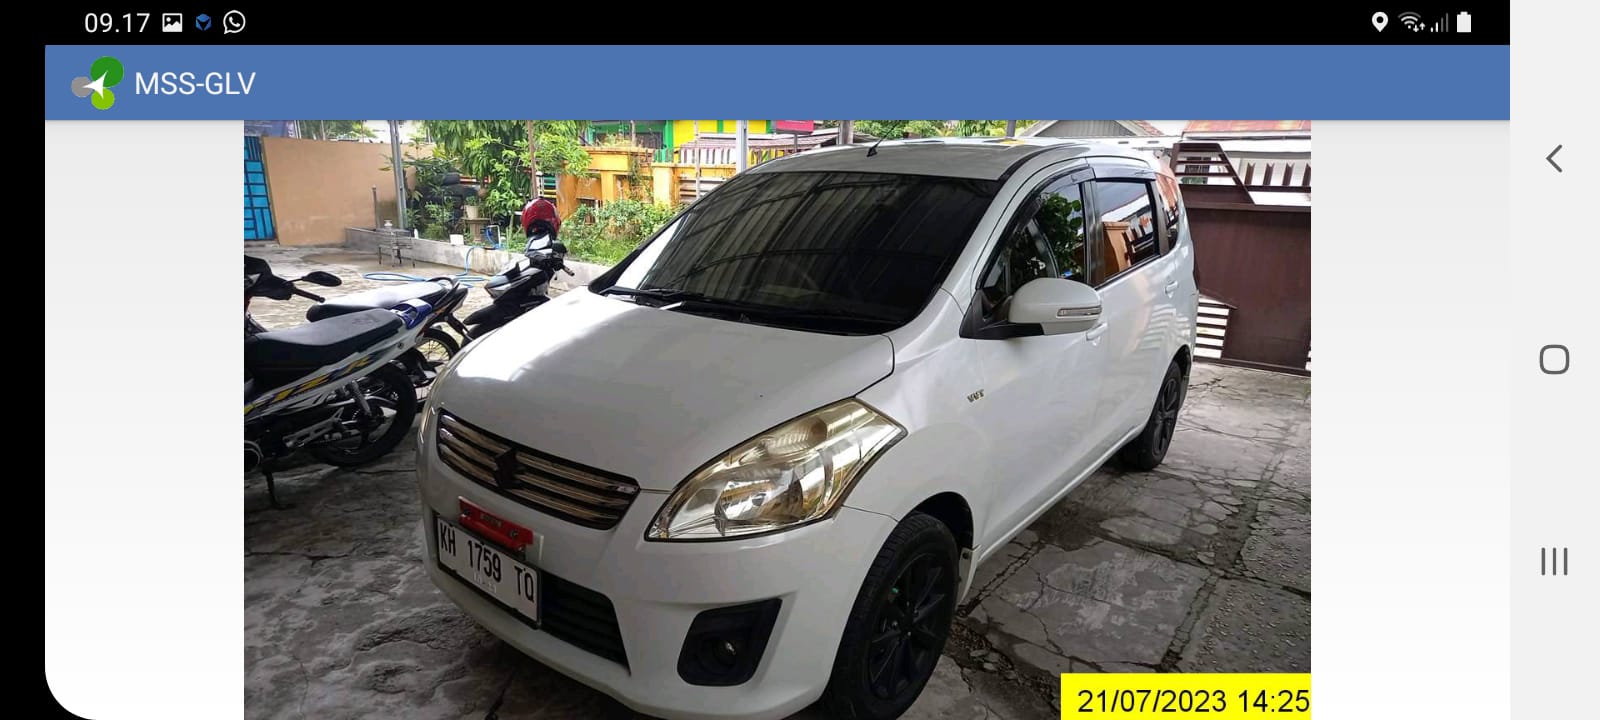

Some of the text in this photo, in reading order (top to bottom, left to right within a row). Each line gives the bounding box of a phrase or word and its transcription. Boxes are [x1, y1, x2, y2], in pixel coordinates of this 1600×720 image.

[84, 13, 150, 33] 09.17
[135, 71, 256, 96] MSS-GLV
[440, 522, 535, 604] KH 1759 TQ
